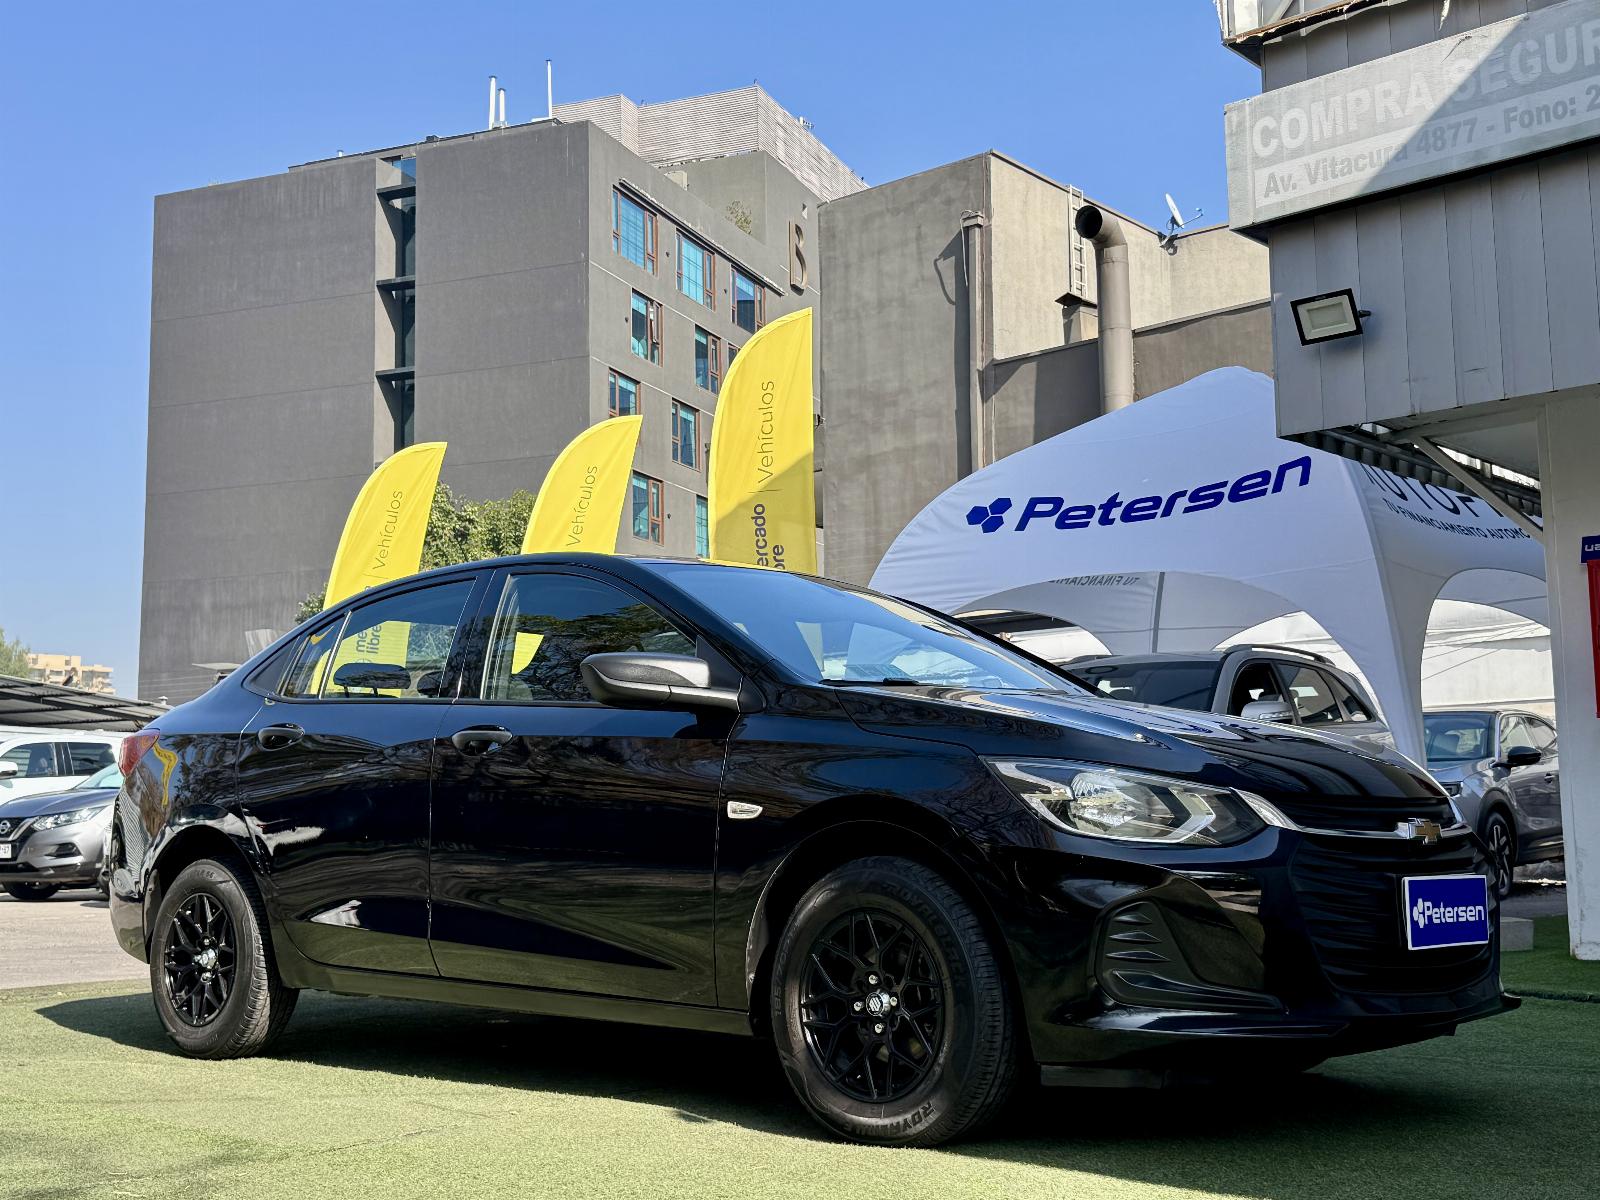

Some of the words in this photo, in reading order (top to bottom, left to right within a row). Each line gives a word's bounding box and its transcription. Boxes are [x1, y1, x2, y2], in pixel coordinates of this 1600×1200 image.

[1252, 70, 1435, 158] COMPRA
[1264, 171, 1297, 198] Av.
[1303, 142, 1408, 186] Vitacura
[1415, 117, 1479, 154] 4877
[1504, 95, 1577, 133] Fono:
[757, 380, 775, 484] Vehículos
[372, 489, 404, 571] Vehículos
[566, 465, 598, 547] Vehículos
[1014, 455, 1312, 532] Petersen
[1397, 505, 1488, 539] FINANCIAMIENTO
[751, 503, 769, 567] ercado
[1423, 901, 1485, 925] Petersen
